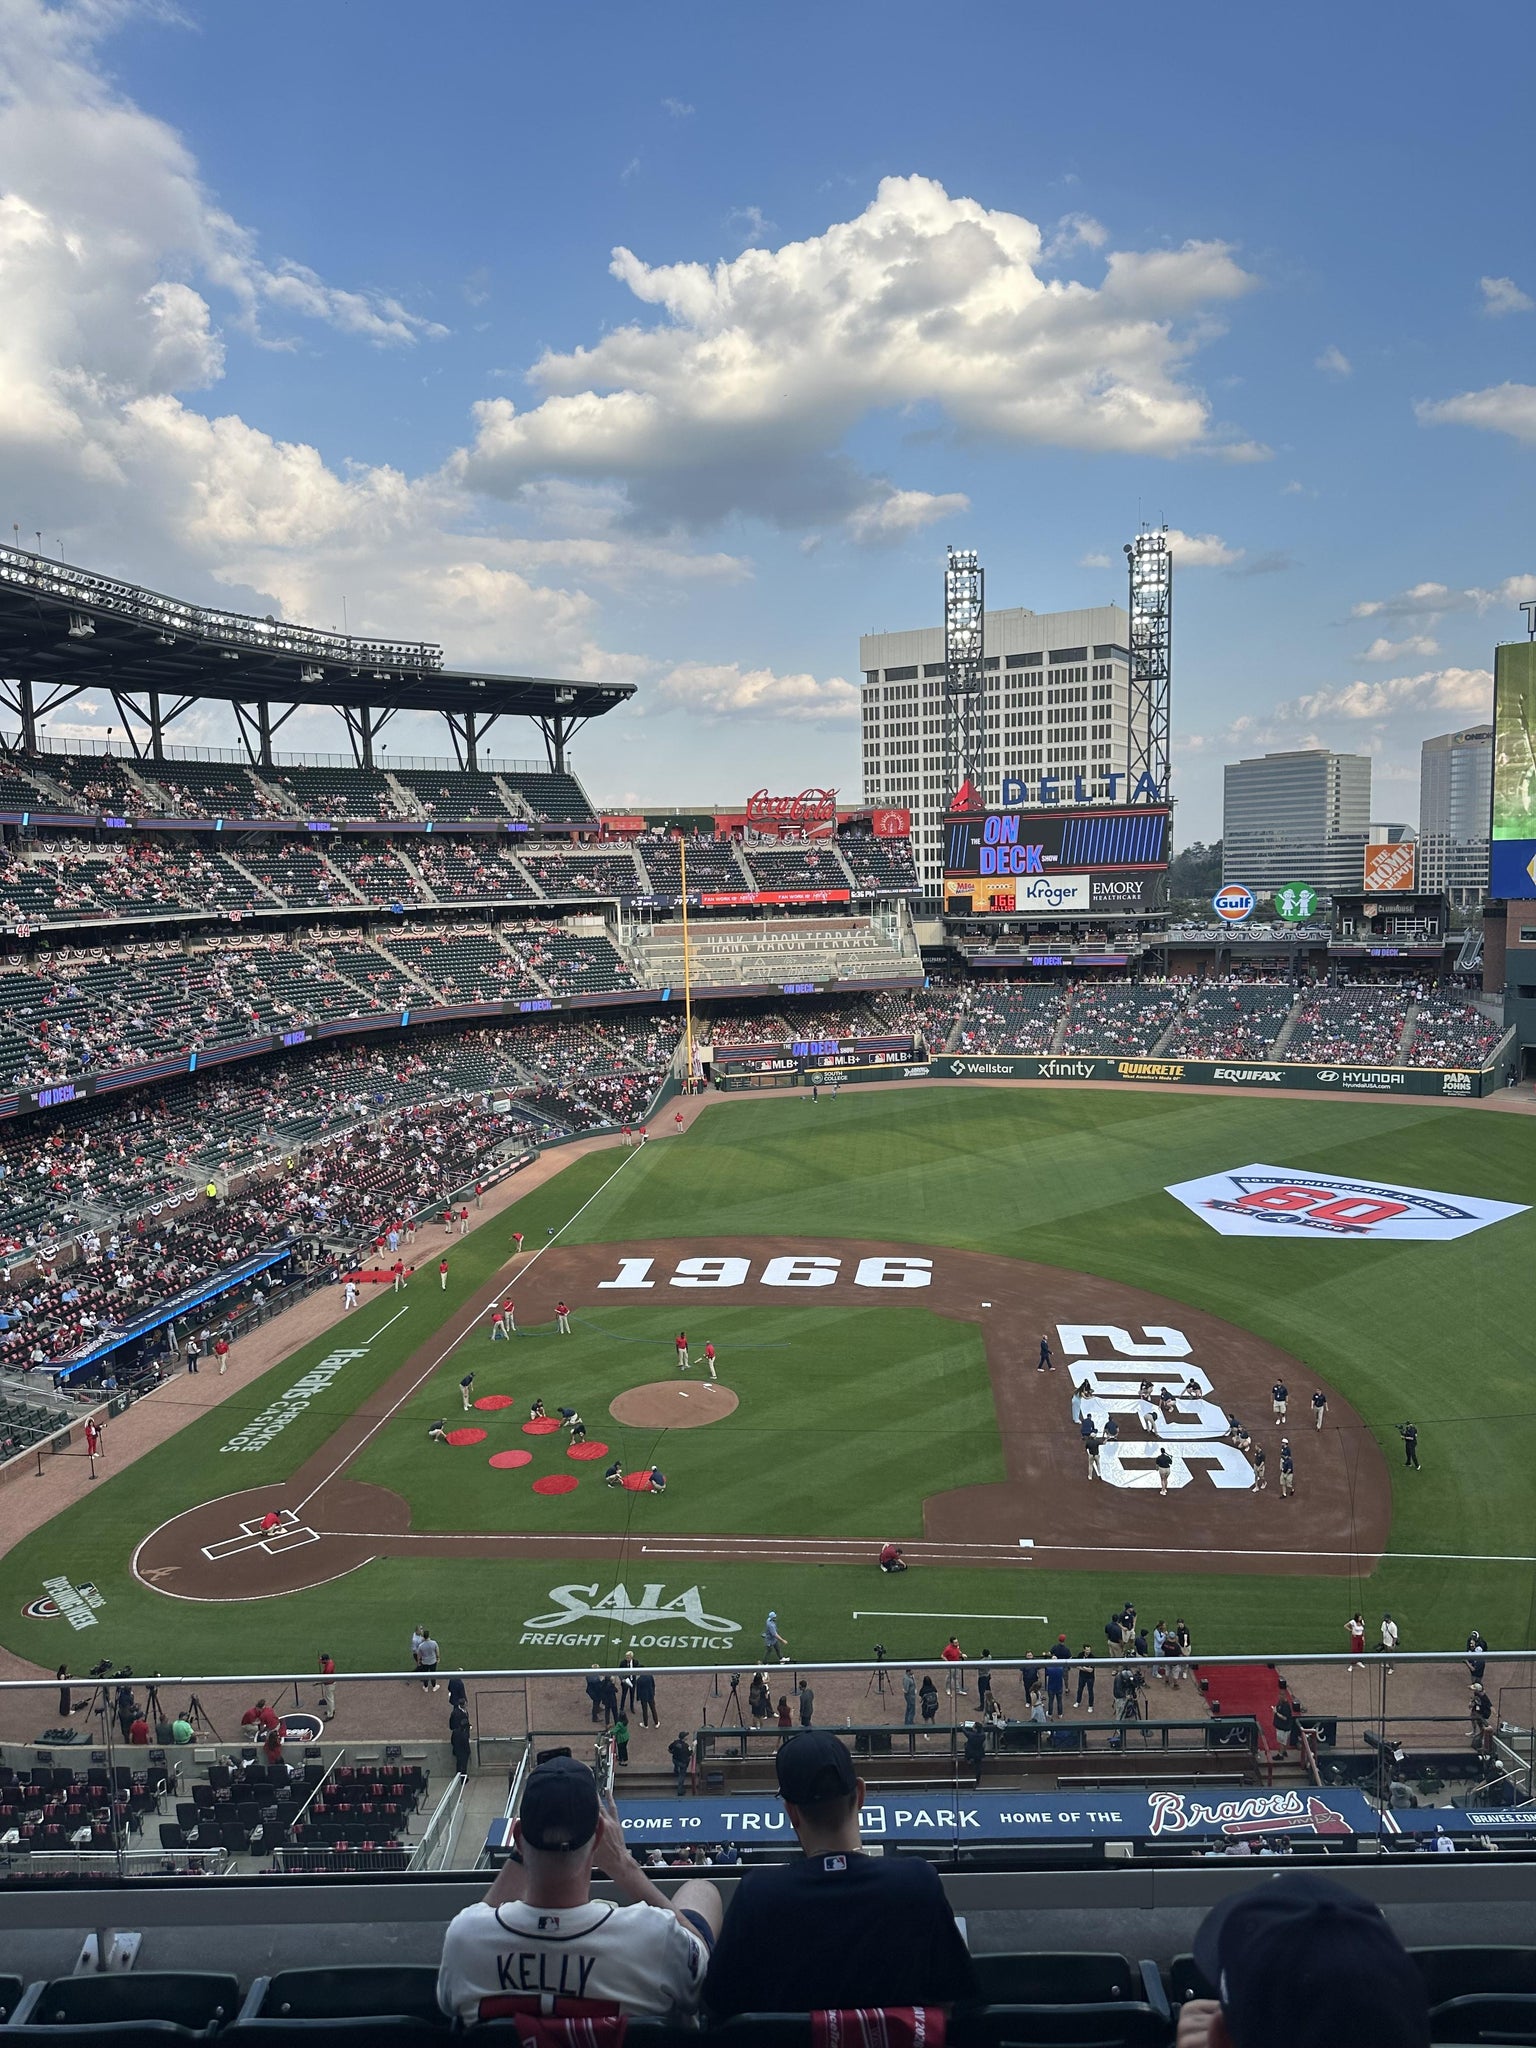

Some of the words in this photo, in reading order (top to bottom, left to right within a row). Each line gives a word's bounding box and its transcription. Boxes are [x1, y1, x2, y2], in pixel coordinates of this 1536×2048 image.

[1003, 771, 1162, 805] DELTA
[984, 815, 1020, 844] ON
[980, 845, 1044, 874] DECK
[1365, 843, 1413, 889] HOME
[1370, 849, 1390, 868] THE
[1383, 861, 1413, 889] DEPOT
[865, 890, 875, 898] PM
[1027, 879, 1078, 906] Kroger
[1093, 881, 1144, 895] EMORY
[994, 895, 1015, 906] 166
[1216, 897, 1251, 908] Gulf
[1378, 904, 1415, 914] CLUBHOUSE
[16, 924, 30, 937] 44
[707, 935, 749, 953] HANK
[752, 933, 805, 951] AARON
[806, 930, 879, 949] TERRACE
[1032, 956, 1042, 966] ON
[1045, 956, 1063, 965] DECK
[520, 1001, 532, 1013] ON
[532, 999, 552, 1012] DECK
[792, 1041, 808, 1057] ON
[810, 1040, 840, 1056] DECK
[773, 1060, 799, 1069] MLB+
[834, 1056, 861, 1065] MLB+
[886, 1052, 913, 1063] MLB+
[967, 1063, 1014, 1073] Wellstar
[1038, 1059, 1096, 1078] xfinity
[1118, 1062, 1185, 1076] QUIKRETE
[1213, 1068, 1282, 1082] EQUIFAX
[1342, 1072, 1405, 1084] HYUNDAI
[1342, 1082, 1391, 1090] HyundaiUSA.com
[1443, 1072, 1471, 1083] PAPA
[1442, 1083, 1472, 1091] JOHNS
[39, 1090, 52, 1108] ON
[53, 1084, 76, 1105] DECK
[1283, 1179, 1390, 1197] ANNIVERSARY
[1234, 1185, 1412, 1225] 60
[1218, 1204, 1254, 1215] 1966
[1305, 1220, 1345, 1232] 2026
[597, 1256, 934, 1289] 1966
[1055, 1324, 1256, 1489] 2026
[219, 1401, 290, 1453] CASINOS
[240, 1401, 311, 1452] CHEROKEE
[522, 1583, 743, 1632] SAIA
[519, 1632, 606, 1646] FREIGHT
[629, 1635, 734, 1649] LOGISTICS
[720, 1813, 794, 1830] TRU
[895, 1809, 980, 1828] PARK
[1000, 1812, 1053, 1824] HOME
[1058, 1812, 1082, 1823] OF
[1086, 1811, 1123, 1823] THE
[1148, 1790, 1304, 1836] Braves
[622, 1817, 674, 1829] COME
[679, 1817, 701, 1828] TO
[497, 1952, 596, 1997] KELLY
